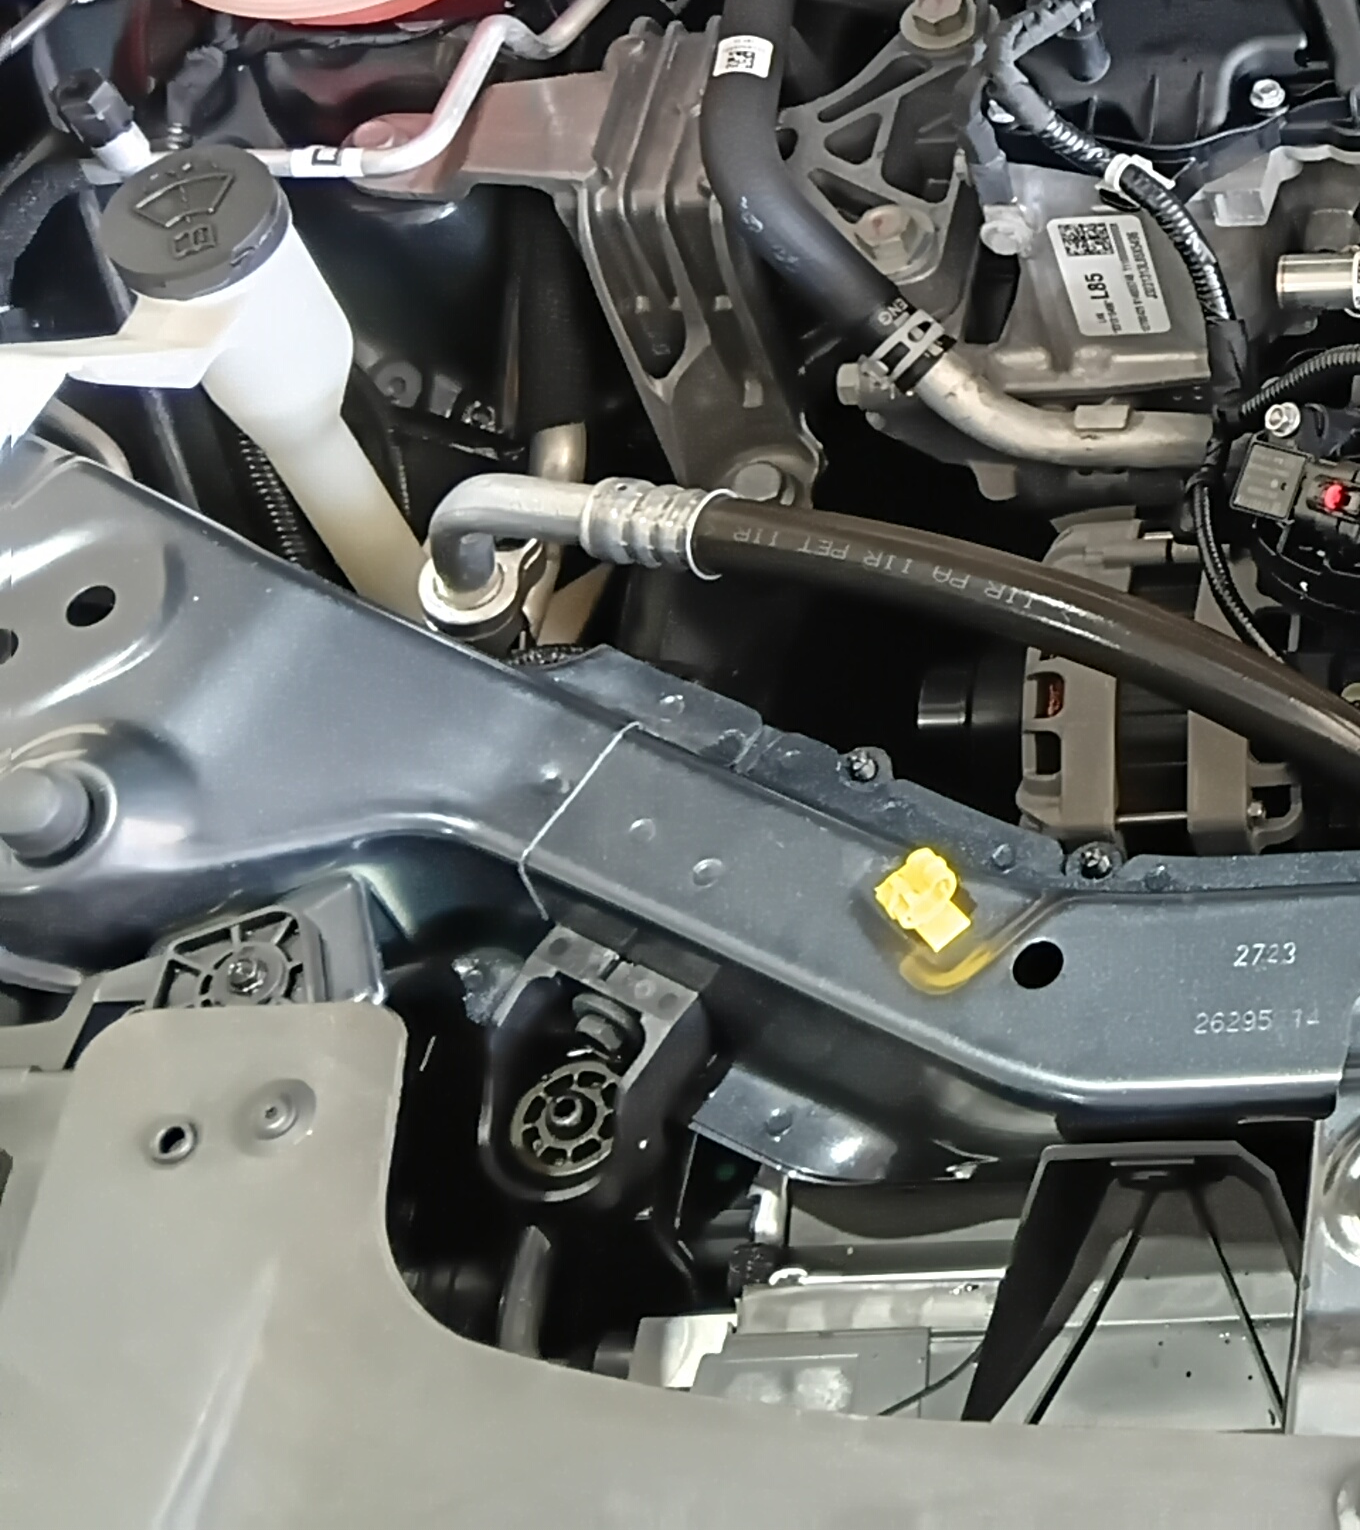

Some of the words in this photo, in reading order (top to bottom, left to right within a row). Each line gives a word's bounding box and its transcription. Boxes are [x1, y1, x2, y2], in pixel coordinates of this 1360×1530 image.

[1084, 272, 1110, 300] L85
[797, 539, 850, 561] PET
[931, 565, 970, 590] PA
[1233, 942, 1297, 967] 2723
[1193, 1009, 1273, 1034] 26295
